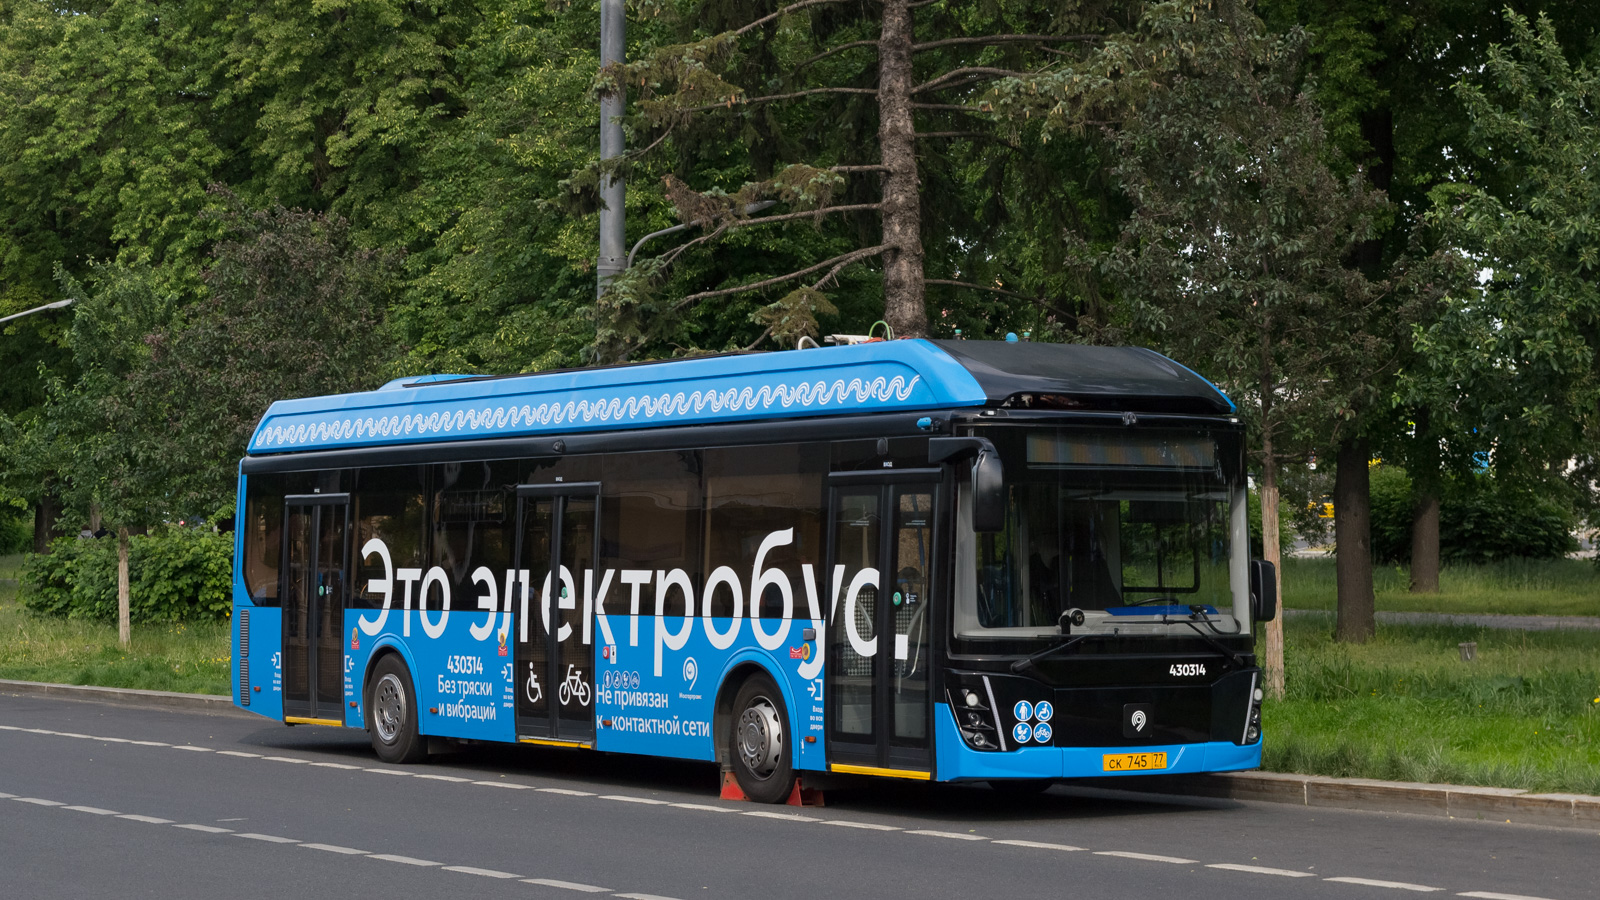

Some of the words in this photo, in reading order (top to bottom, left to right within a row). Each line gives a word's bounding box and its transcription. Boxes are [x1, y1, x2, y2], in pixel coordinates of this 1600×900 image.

[358, 538, 450, 640] Это
[447, 655, 483, 675] 430314
[1169, 664, 1206, 676] 430314
[438, 674, 456, 694] Без
[457, 681, 493, 699] тряски
[596, 684, 612, 705] Не
[614, 690, 669, 710] привязан
[438, 702, 445, 716] и
[446, 699, 496, 722] вибраций
[596, 715, 604, 729] к
[611, 715, 680, 735] контактной
[682, 720, 710, 737] сети
[1127, 755, 1147, 768] 745
[1153, 753, 1164, 763] 77
